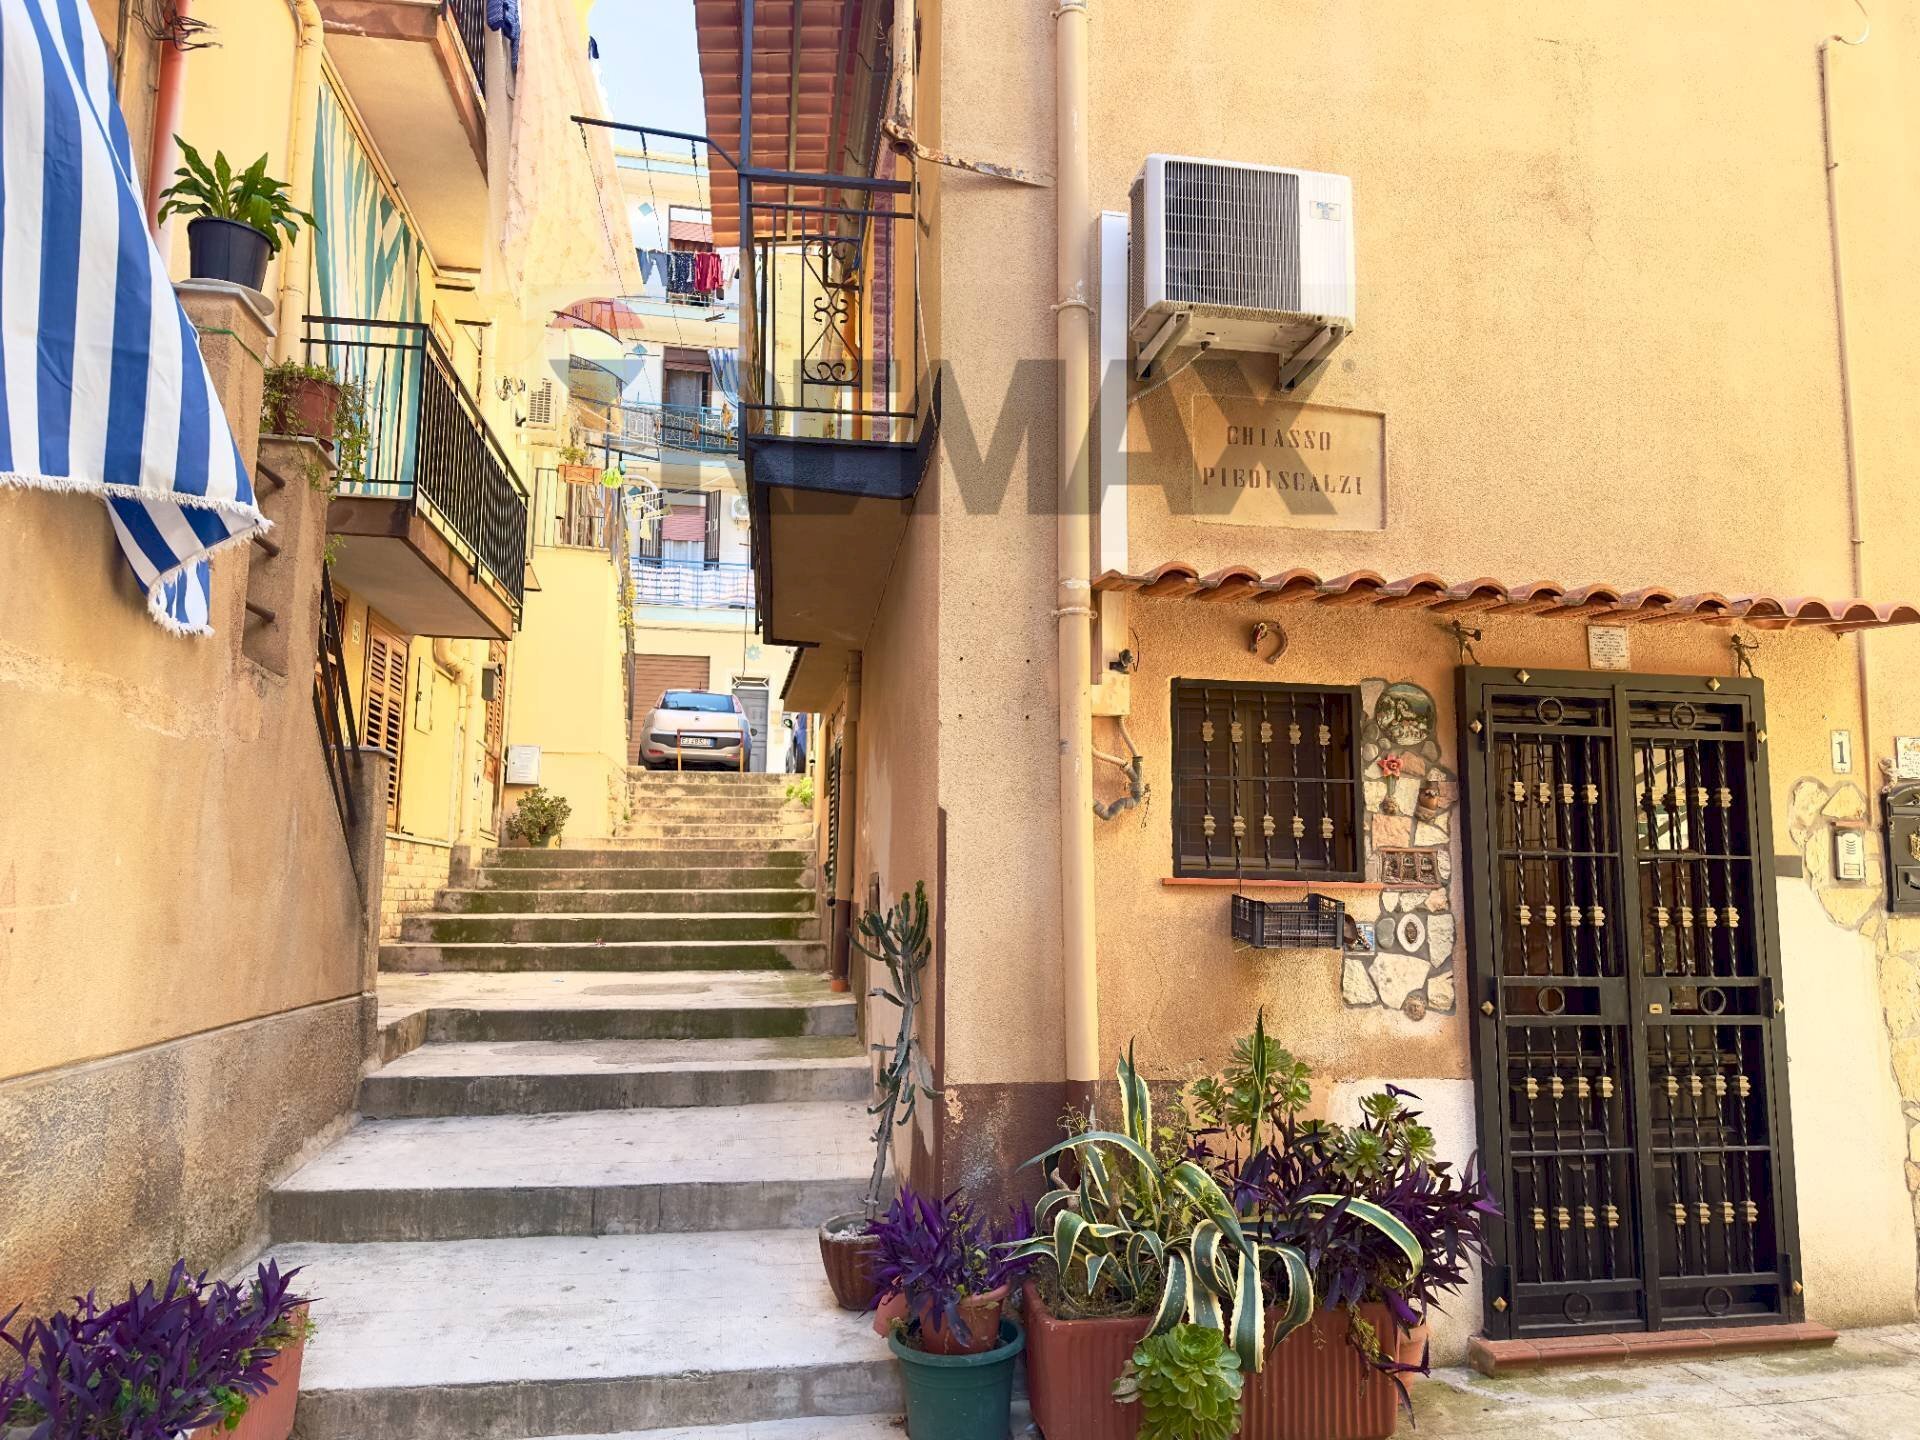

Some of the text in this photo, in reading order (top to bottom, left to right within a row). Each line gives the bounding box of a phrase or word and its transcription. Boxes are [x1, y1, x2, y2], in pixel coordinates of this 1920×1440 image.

[1227, 424, 1331, 451] CHIASSO
[1202, 466, 1362, 496] PIEDISCALZI
[1835, 740, 1847, 764] 1
